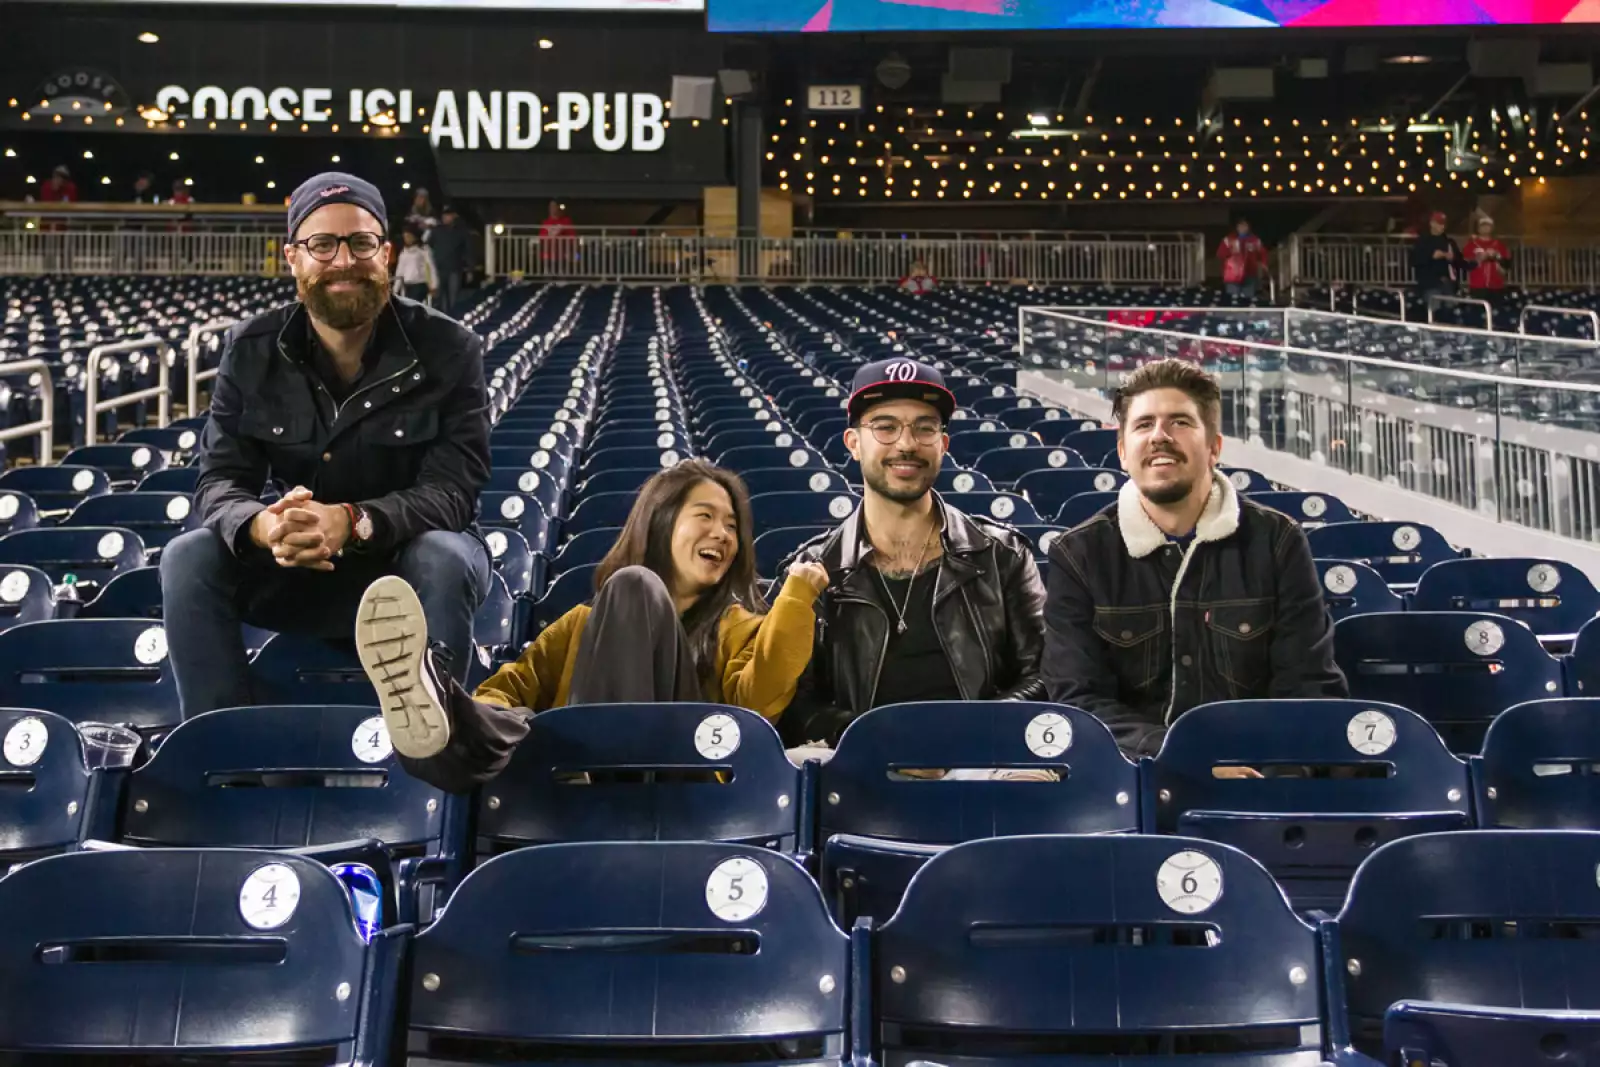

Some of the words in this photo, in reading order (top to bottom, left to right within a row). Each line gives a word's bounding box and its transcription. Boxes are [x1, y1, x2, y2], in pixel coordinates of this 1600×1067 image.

[819, 89, 852, 106] 112
[557, 91, 666, 152] PUB
[1402, 532, 1410, 544] 9
[1335, 572, 1344, 584] 8
[1538, 571, 1547, 584] 9
[147, 638, 157, 652] 3
[1479, 631, 1489, 645] 8
[367, 731, 380, 748] 4
[711, 727, 723, 745] 5
[1042, 726, 1055, 744] 6
[1365, 724, 1377, 741] 7
[19, 732, 31, 751] 3
[728, 876, 743, 901] 5
[1181, 874, 1198, 894] 6
[262, 884, 278, 908] 4
